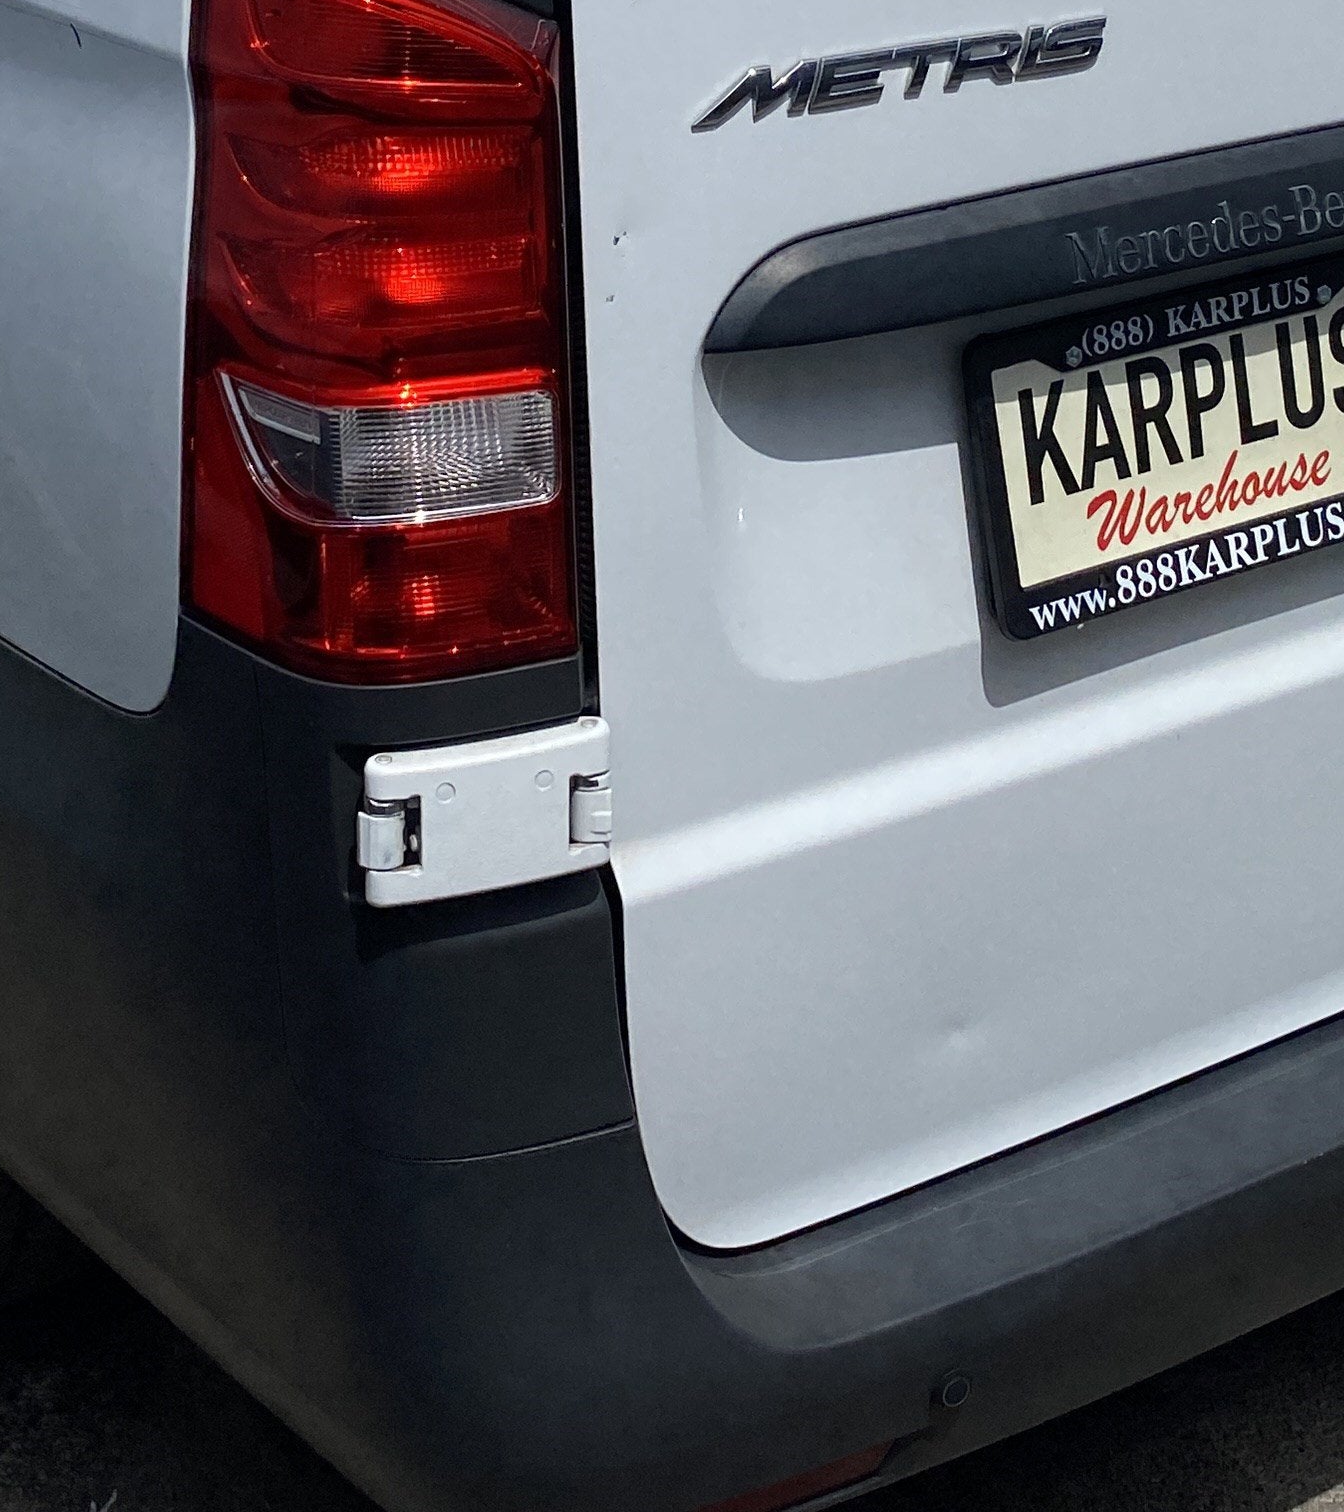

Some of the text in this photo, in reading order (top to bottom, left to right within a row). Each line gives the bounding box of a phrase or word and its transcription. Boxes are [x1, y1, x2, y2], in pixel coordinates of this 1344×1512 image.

[691, 15, 1106, 134] METRIS
[1082, 275, 1311, 358] (888) KARPLUS
[1086, 449, 1331, 551] Warehouse
